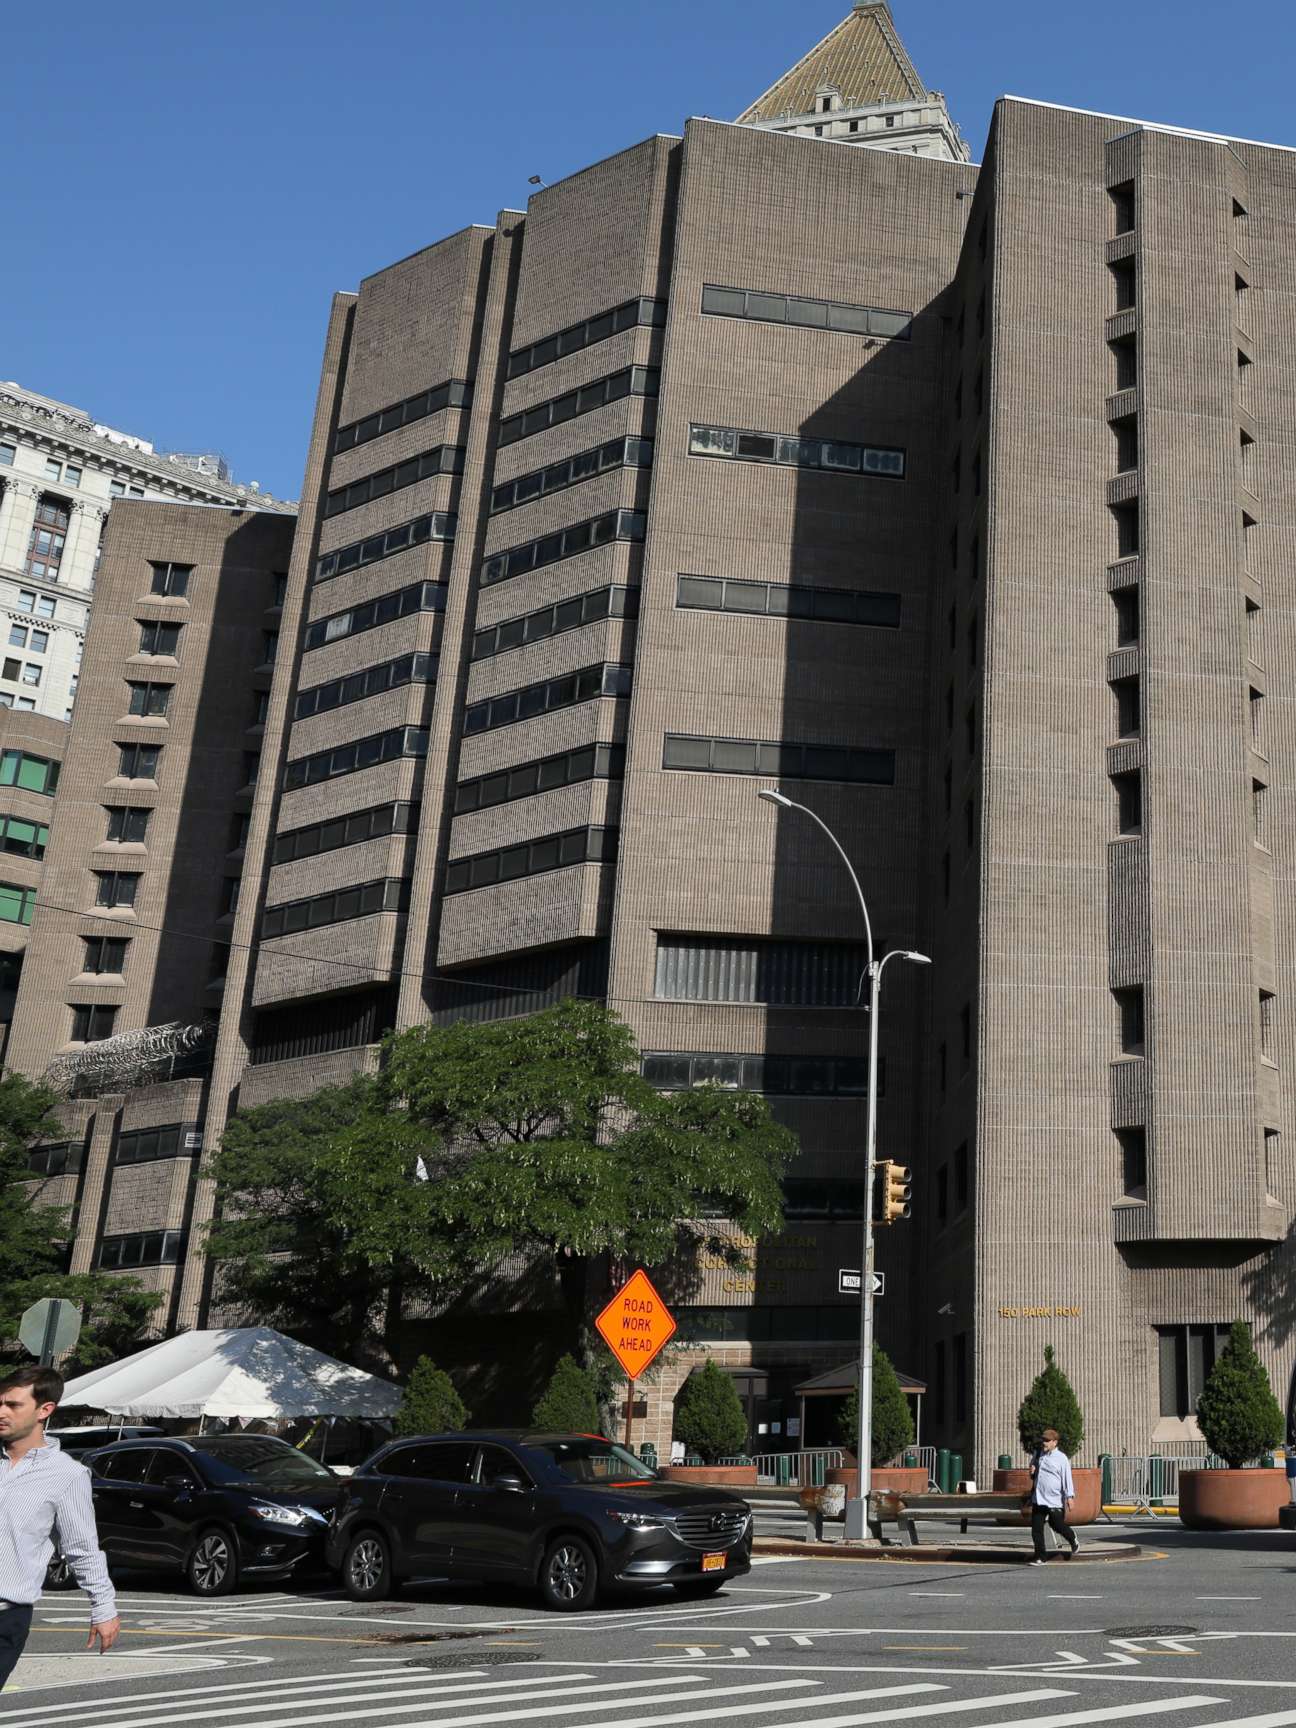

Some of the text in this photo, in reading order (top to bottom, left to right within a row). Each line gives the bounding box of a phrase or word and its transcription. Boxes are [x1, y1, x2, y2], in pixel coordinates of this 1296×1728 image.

[846, 1277, 859, 1286] ONE
[623, 1298, 653, 1313] ROAD
[998, 1305, 1081, 1318] 150 PARK ROW
[622, 1316, 651, 1332] WORK
[619, 1337, 652, 1352] AHEAD
